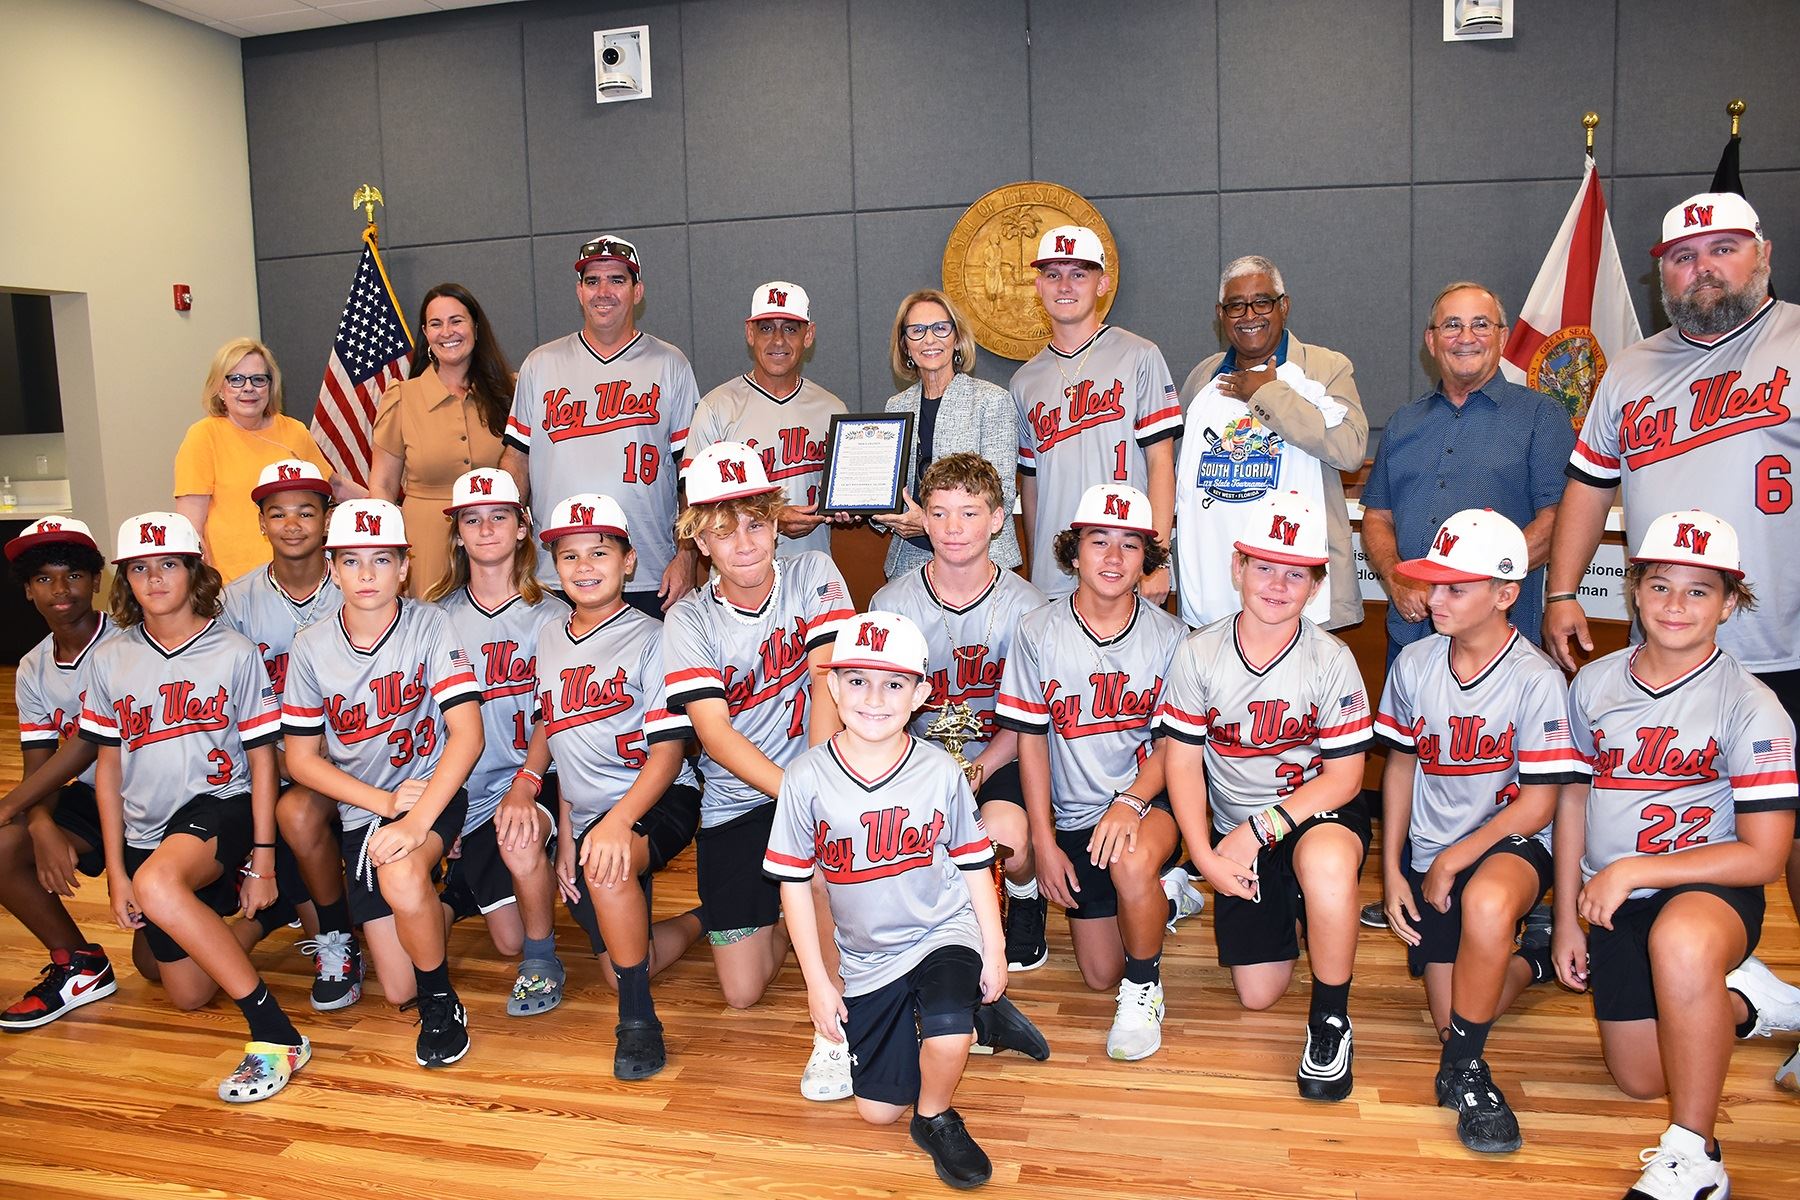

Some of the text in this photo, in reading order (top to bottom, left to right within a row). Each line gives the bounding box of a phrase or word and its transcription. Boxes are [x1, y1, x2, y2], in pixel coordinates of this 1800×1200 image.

[1034, 187, 1074, 211] STATE
[1684, 203, 1713, 228] KW
[1054, 235, 1077, 256] KW
[767, 288, 787, 308] KW
[1540, 332, 1566, 355] GREAT
[542, 380, 660, 432] Key West
[1028, 378, 1125, 442] Key West
[1619, 366, 1791, 454] Key West
[623, 442, 660, 485] 18
[778, 426, 829, 466] Wes
[1113, 441, 1127, 480] 1
[278, 464, 301, 480] KW
[470, 476, 493, 496] KW
[719, 458, 748, 484] KW
[1201, 462, 1230, 477] SOUTH
[1755, 455, 1793, 515] 6
[355, 511, 381, 536] KW
[570, 502, 594, 526] KW
[1104, 494, 1130, 520] KW
[140, 522, 167, 547] KW
[1269, 514, 1301, 546] KW
[1673, 522, 1711, 555] KW
[856, 621, 889, 652] KW
[481, 640, 537, 686] Wes
[559, 664, 634, 714] West
[1088, 671, 1163, 719] West
[113, 679, 229, 741] Key West
[323, 693, 369, 735] Key
[1247, 699, 1319, 746] West
[387, 715, 437, 768] 33
[615, 730, 648, 769] 5
[1448, 715, 1516, 762] West
[1628, 726, 1719, 777] West
[207, 747, 233, 785] 3
[814, 806, 945, 872] Key West
[1636, 803, 1716, 854] 22
